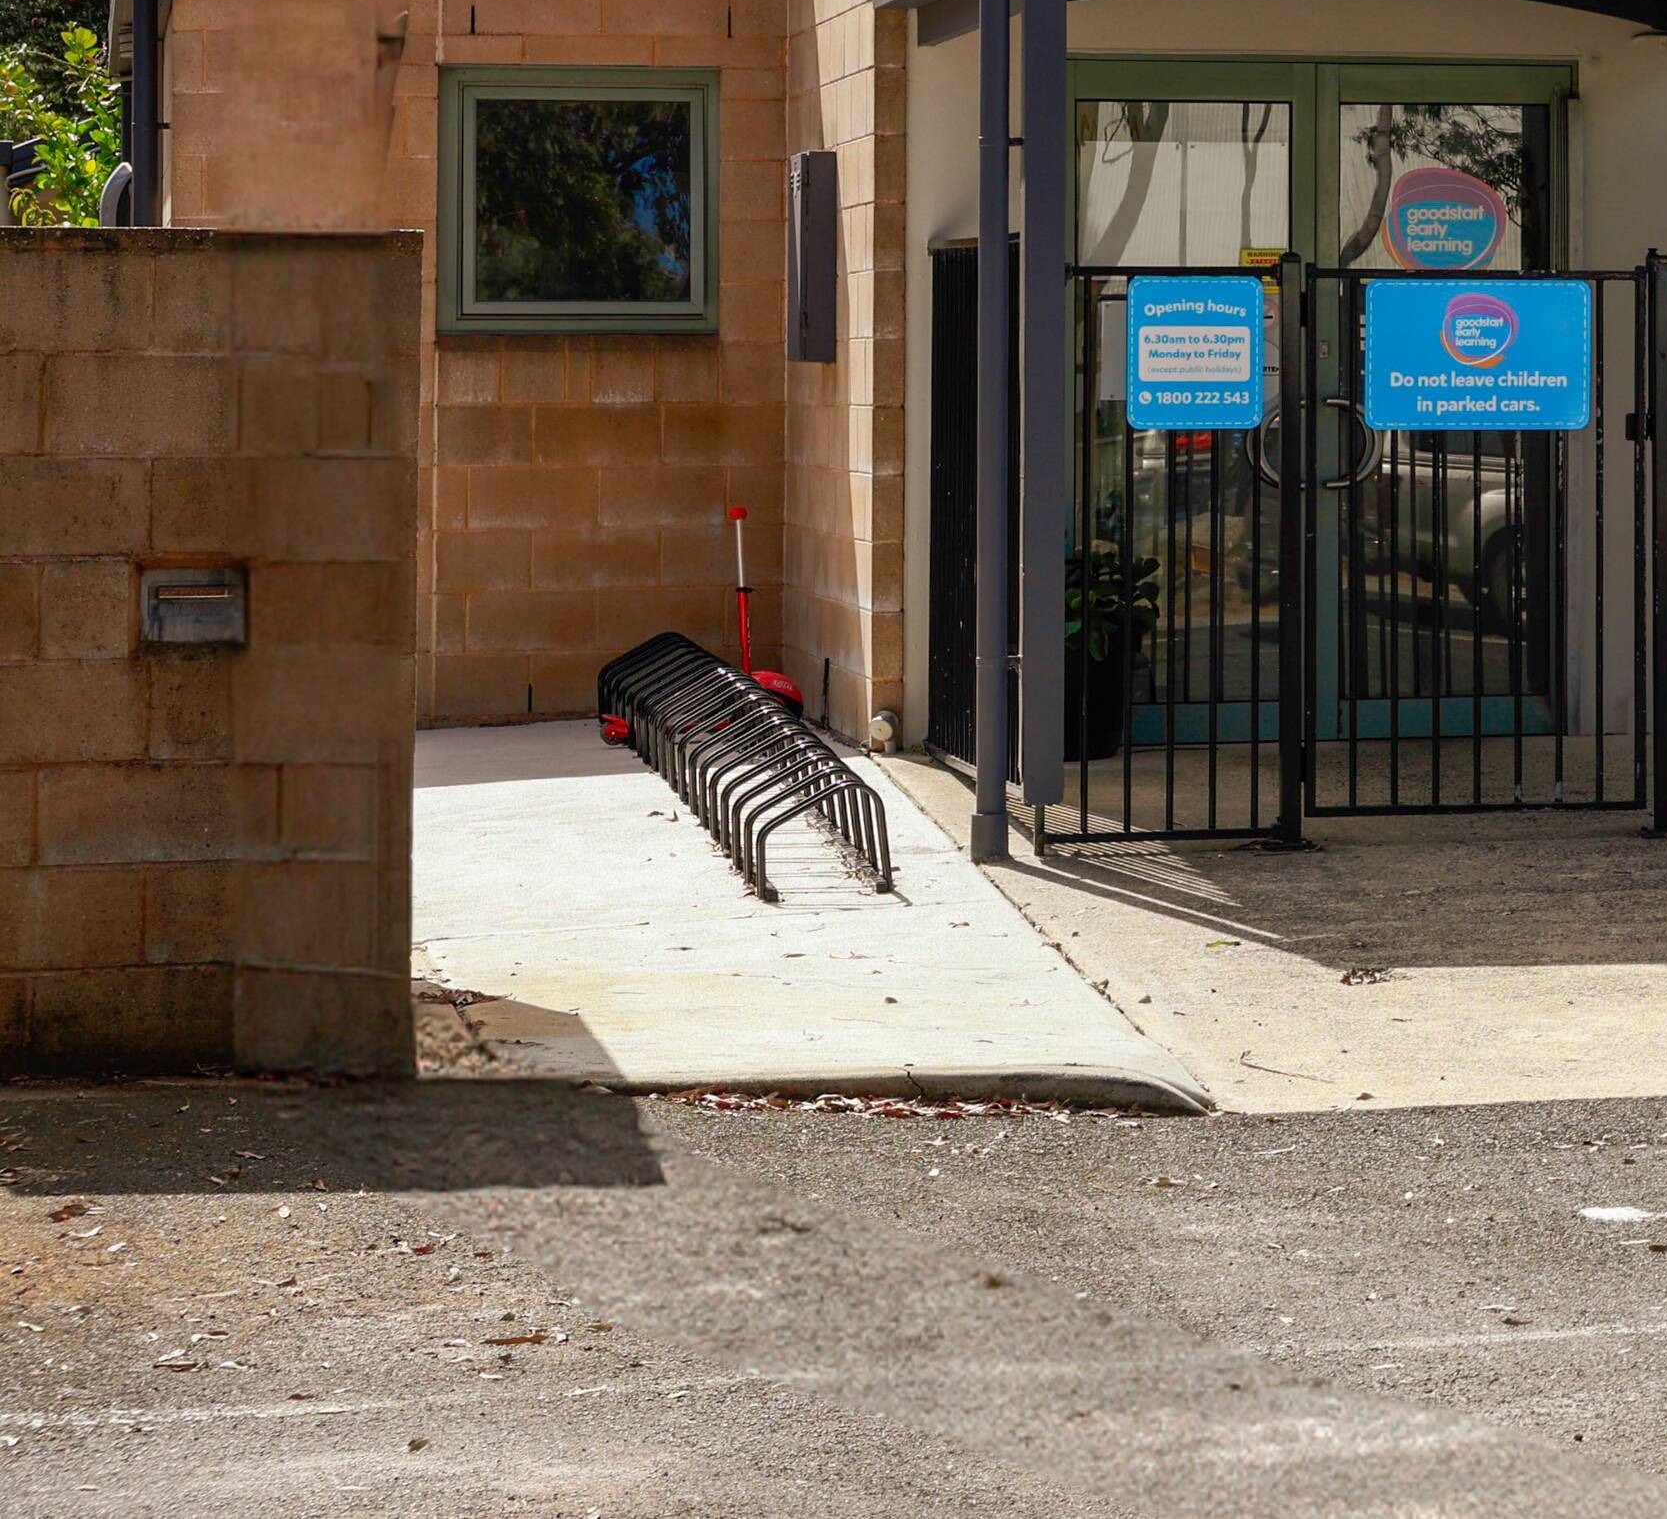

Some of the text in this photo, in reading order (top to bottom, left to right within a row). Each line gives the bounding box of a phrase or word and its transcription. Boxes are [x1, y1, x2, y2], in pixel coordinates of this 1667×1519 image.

[1407, 205, 1485, 223] goodstart
[1407, 221, 1448, 238] early
[1407, 237, 1473, 255] learning
[1144, 299, 1247, 317] Opening hours
[1455, 316, 1504, 329] goodstart
[1455, 327, 1481, 338] early
[1144, 334, 1245, 346] 6.30am to 6.30pm
[1455, 337, 1497, 348] learning
[1148, 349, 1242, 361] Monday to Friday
[1390, 371, 1568, 387] Do not leave children
[1155, 392, 1250, 404] 1800 222 543
[1416, 395, 1541, 416] in parked cars.
